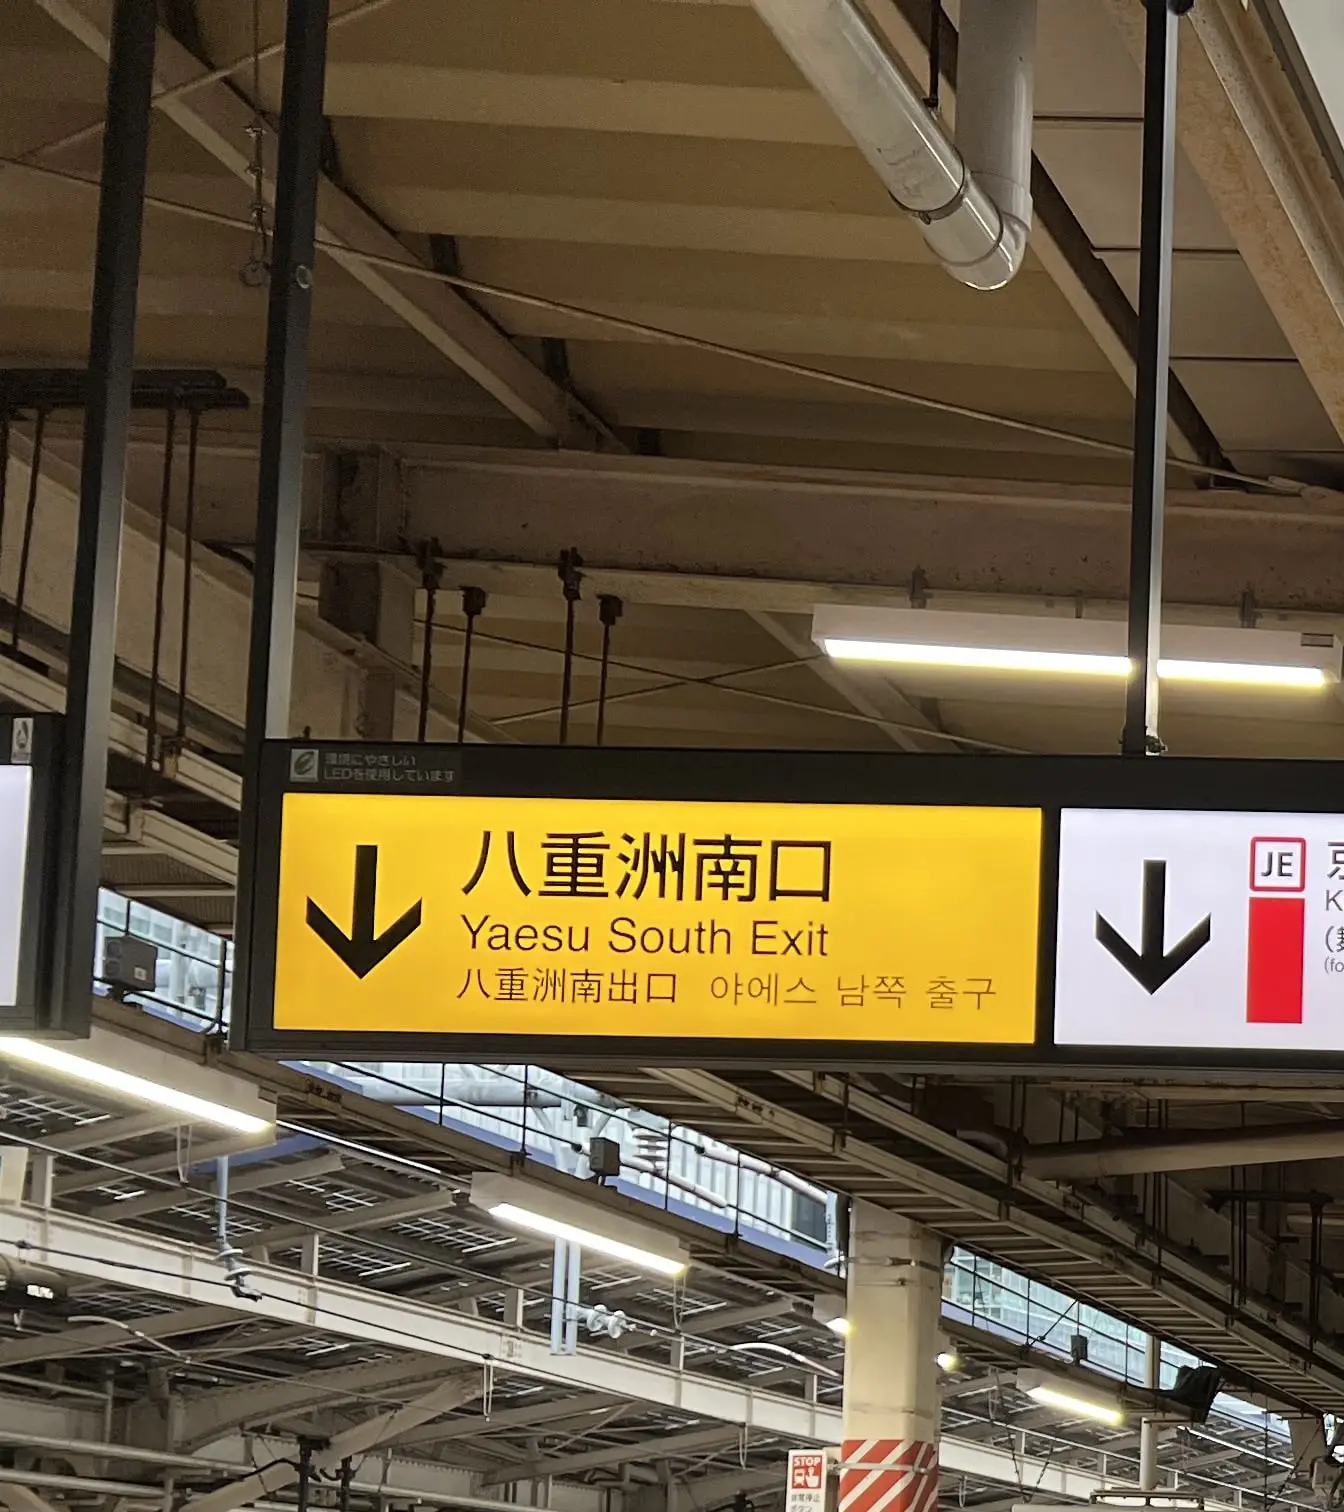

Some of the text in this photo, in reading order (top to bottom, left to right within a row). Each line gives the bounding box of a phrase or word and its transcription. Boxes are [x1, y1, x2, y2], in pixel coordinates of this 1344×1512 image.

[460, 829, 832, 903] 八重洲南口
[1261, 852, 1293, 879] JE
[460, 914, 828, 957] Yaesu South Exit
[457, 966, 679, 1004] 八重洲南出口
[709, 974, 997, 1011] 야에스 남쪽 출구
[793, 1457, 820, 1466] STOP
